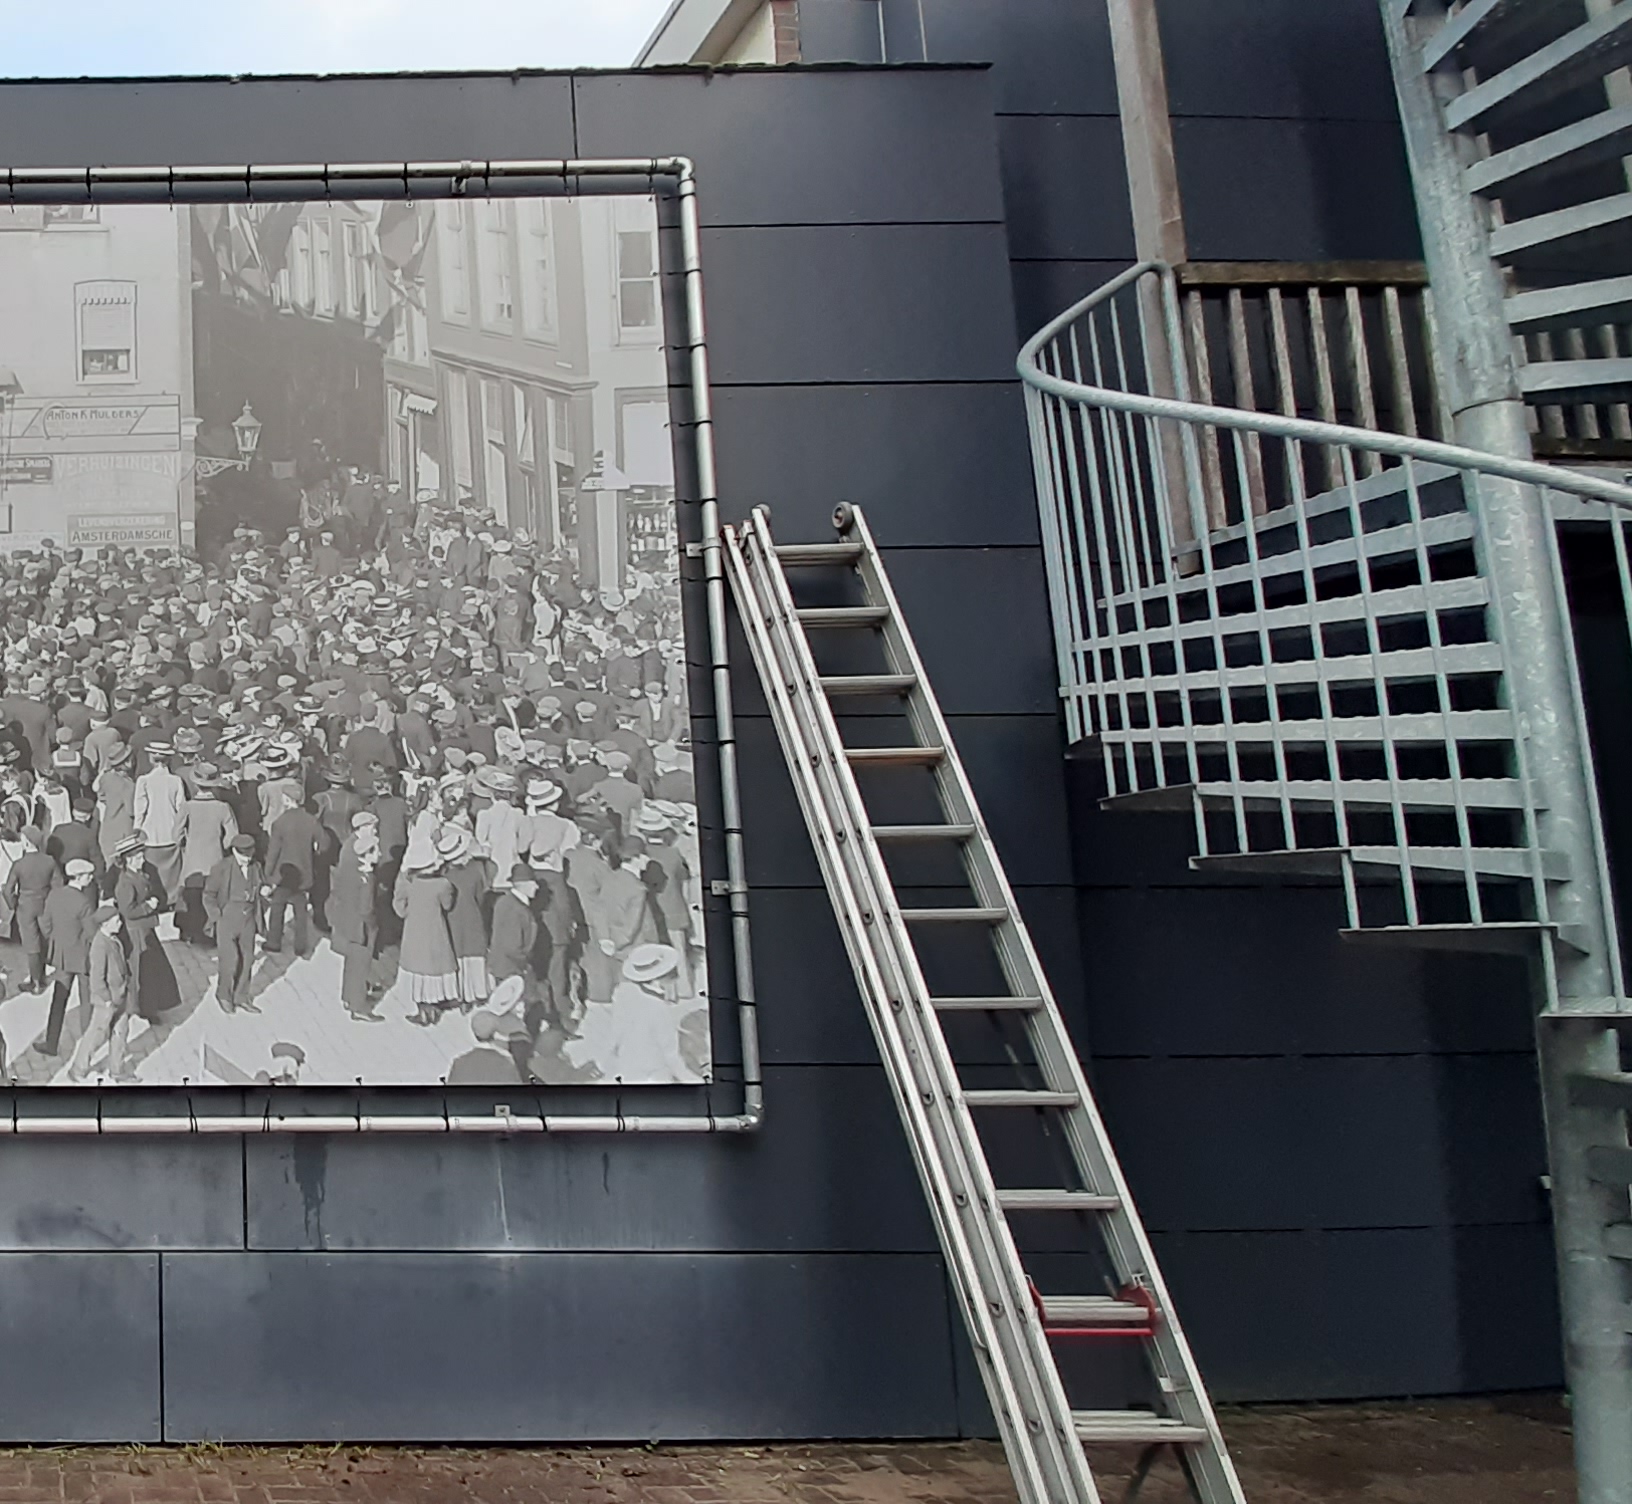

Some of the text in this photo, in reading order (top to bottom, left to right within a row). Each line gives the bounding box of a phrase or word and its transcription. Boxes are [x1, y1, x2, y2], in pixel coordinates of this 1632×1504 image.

[46, 409, 79, 421] ANTON
[89, 409, 140, 420] MULDERS
[54, 454, 176, 479] VERHUIZINGEN
[72, 529, 174, 542] AMSTERDAMSCHE
